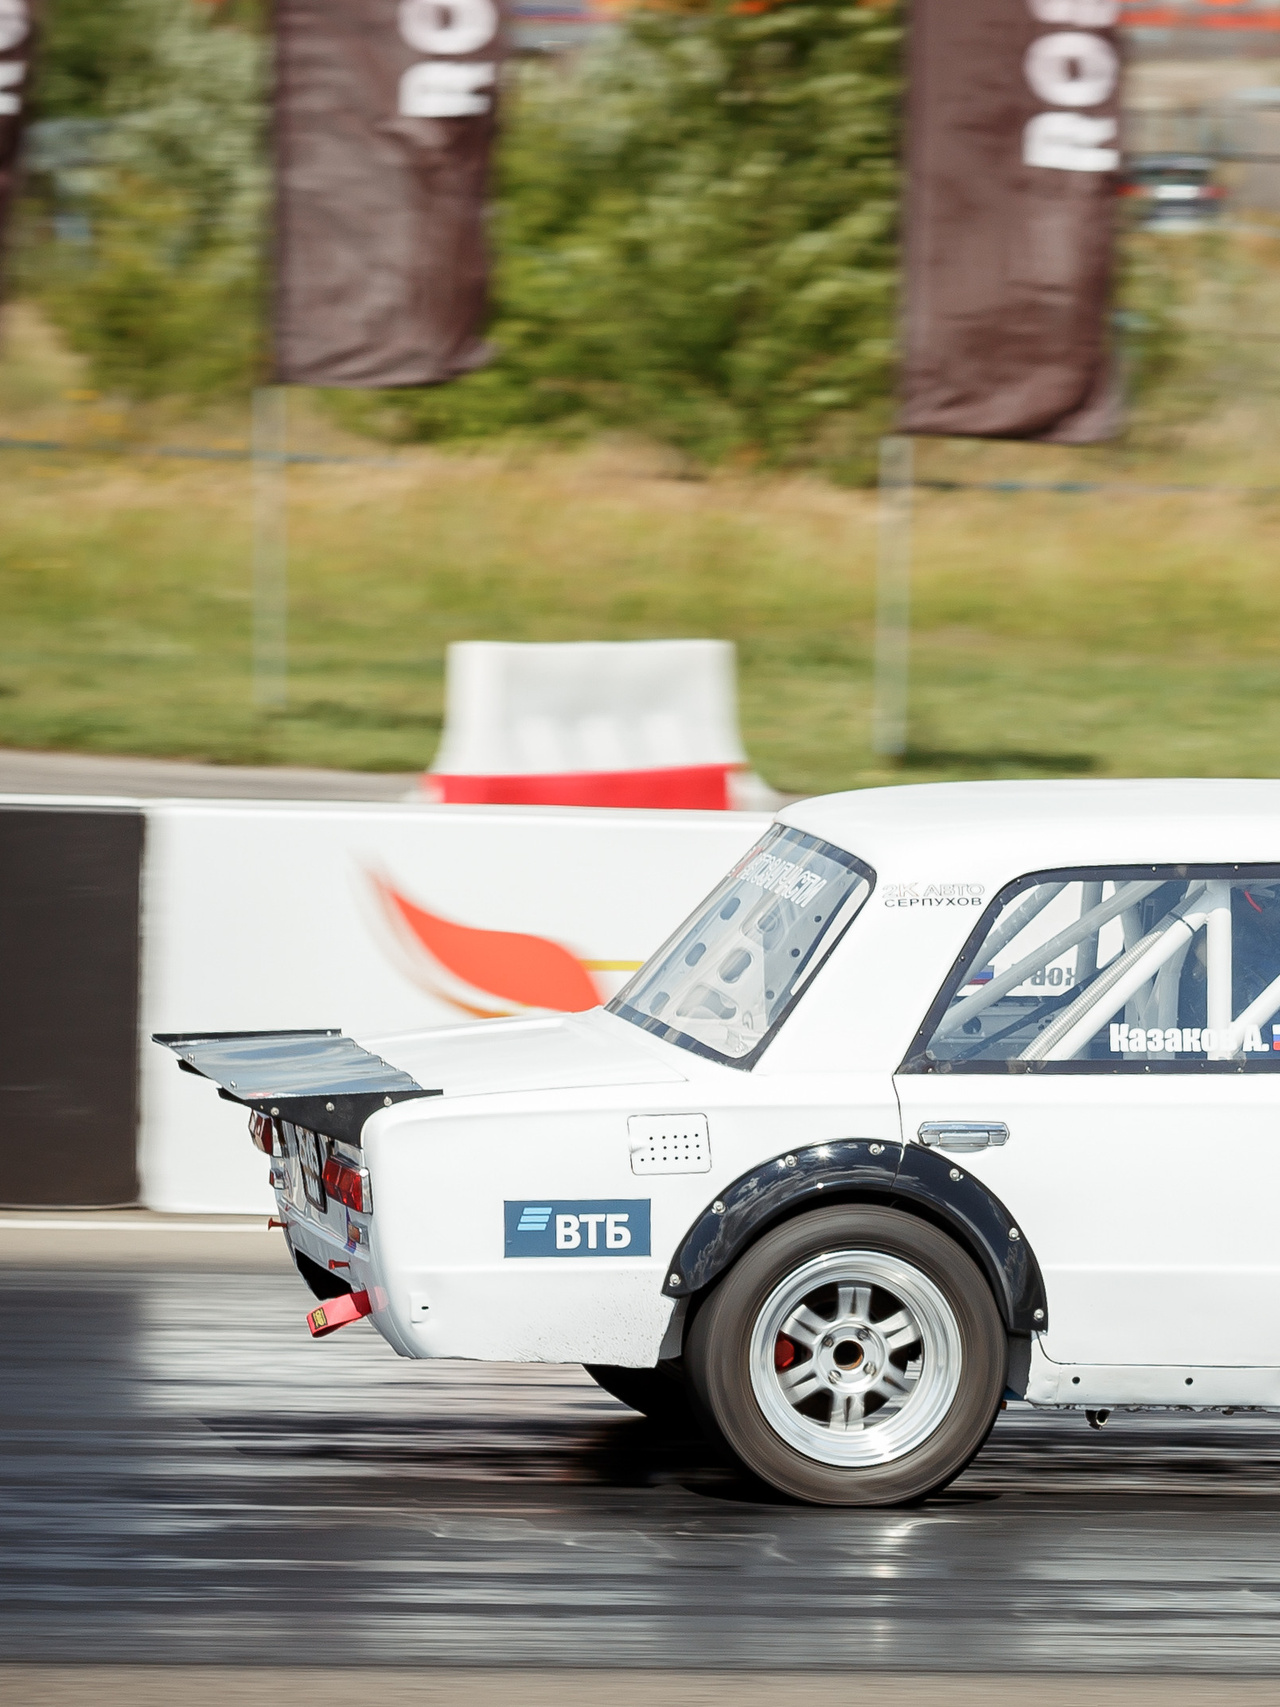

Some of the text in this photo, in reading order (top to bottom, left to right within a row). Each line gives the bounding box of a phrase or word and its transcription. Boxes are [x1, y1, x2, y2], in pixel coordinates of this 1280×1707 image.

[923, 883, 986, 898] АВТО
[884, 897, 983, 908] СЕРПУХОВ
[555, 1213, 632, 1250] ВТБ
